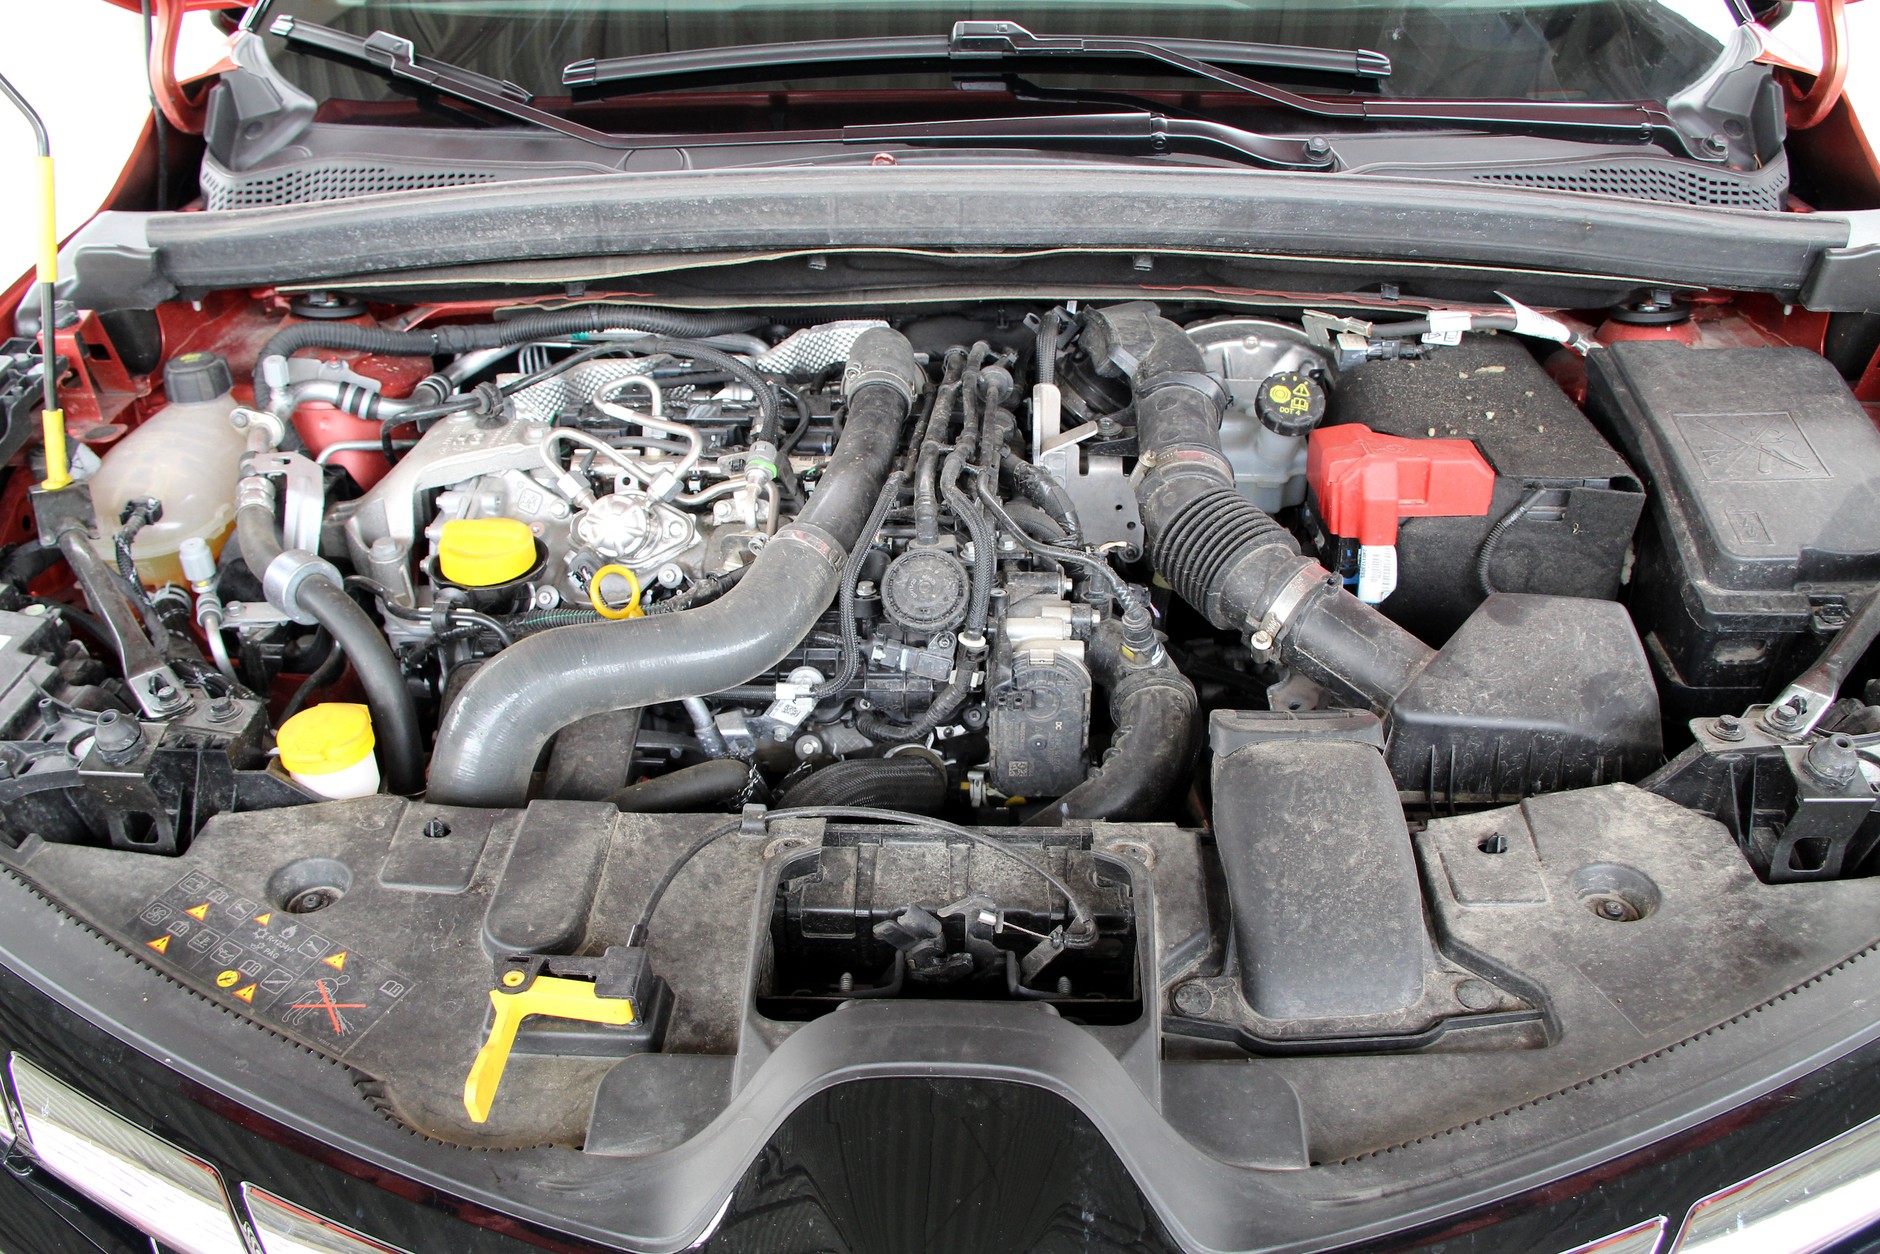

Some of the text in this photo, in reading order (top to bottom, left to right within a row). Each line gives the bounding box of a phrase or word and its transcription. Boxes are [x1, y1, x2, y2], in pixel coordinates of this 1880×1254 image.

[1279, 406, 1294, 415] DOT
[1055, 721, 1063, 731] DC
[266, 935, 296, 953] R-1234yf
[263, 947, 280, 959] PAG
